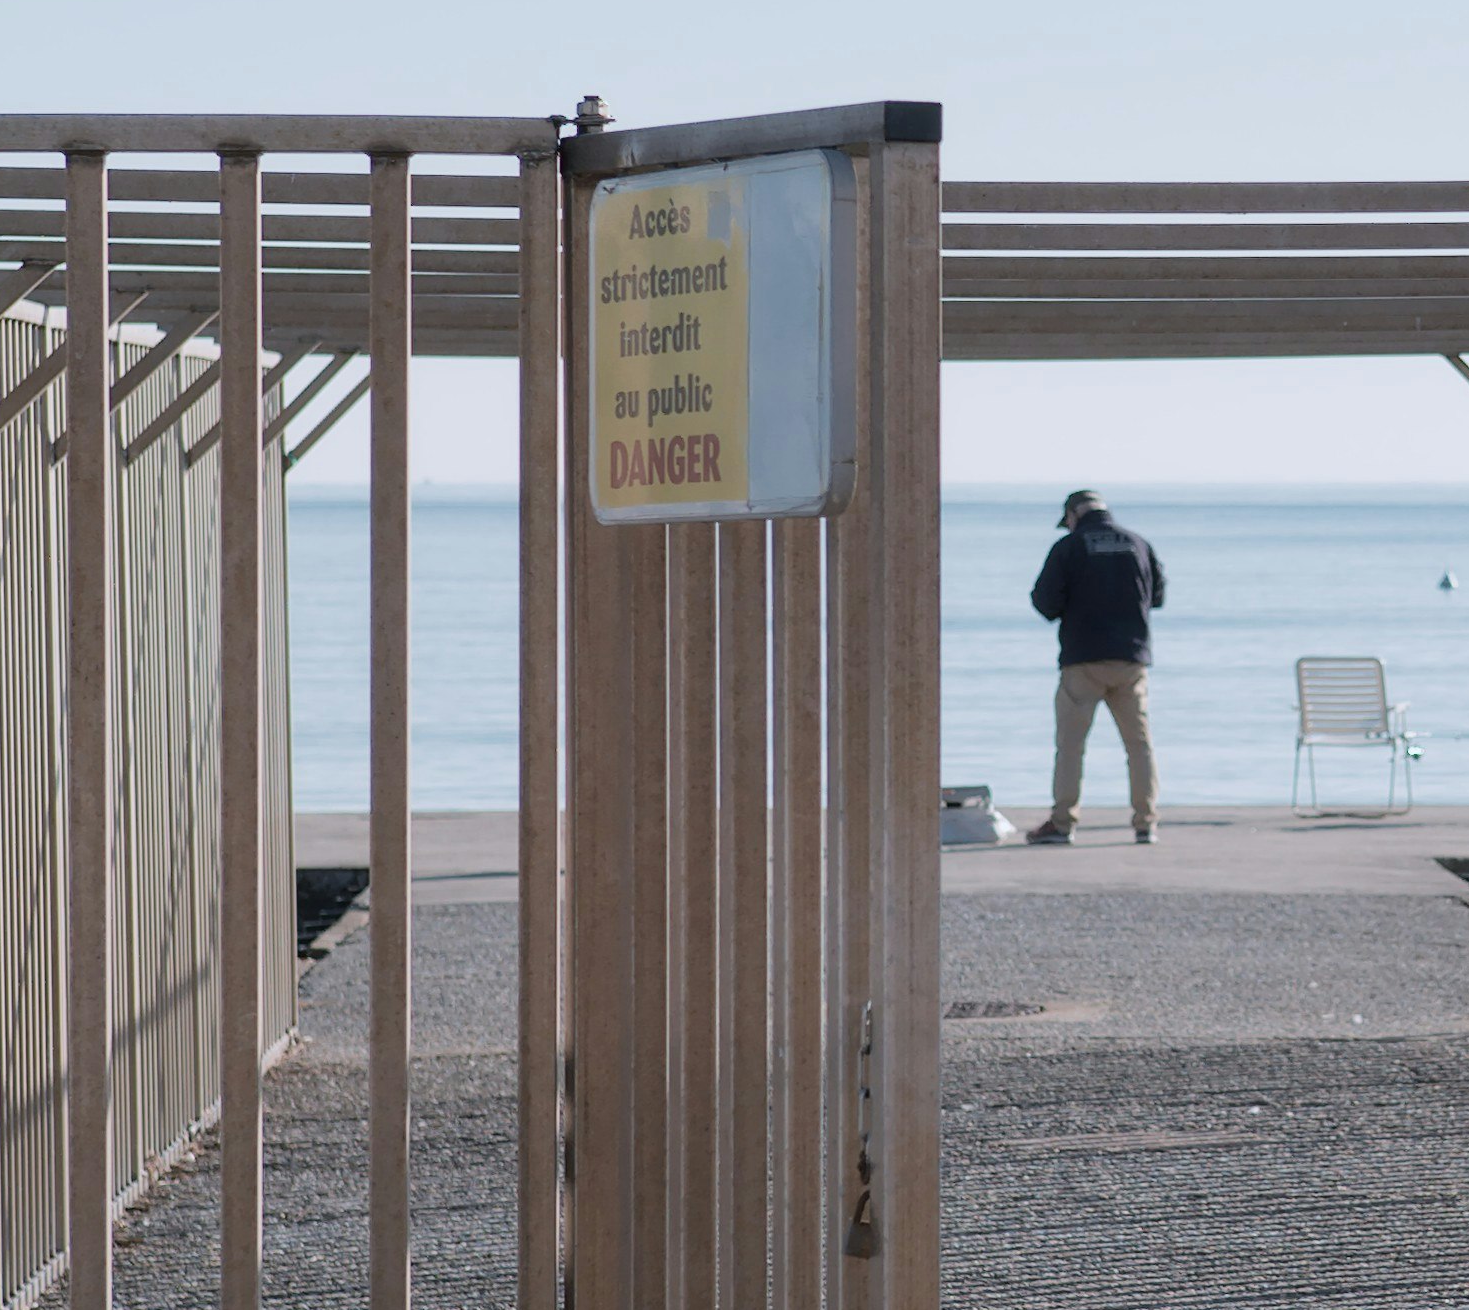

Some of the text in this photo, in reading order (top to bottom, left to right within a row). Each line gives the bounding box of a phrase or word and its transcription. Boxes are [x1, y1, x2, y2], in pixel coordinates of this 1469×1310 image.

[629, 198, 691, 239] Accès
[601, 256, 728, 304] strictement
[620, 312, 701, 357] interdit
[615, 374, 713, 428] au public
[610, 433, 721, 489] DANGER
